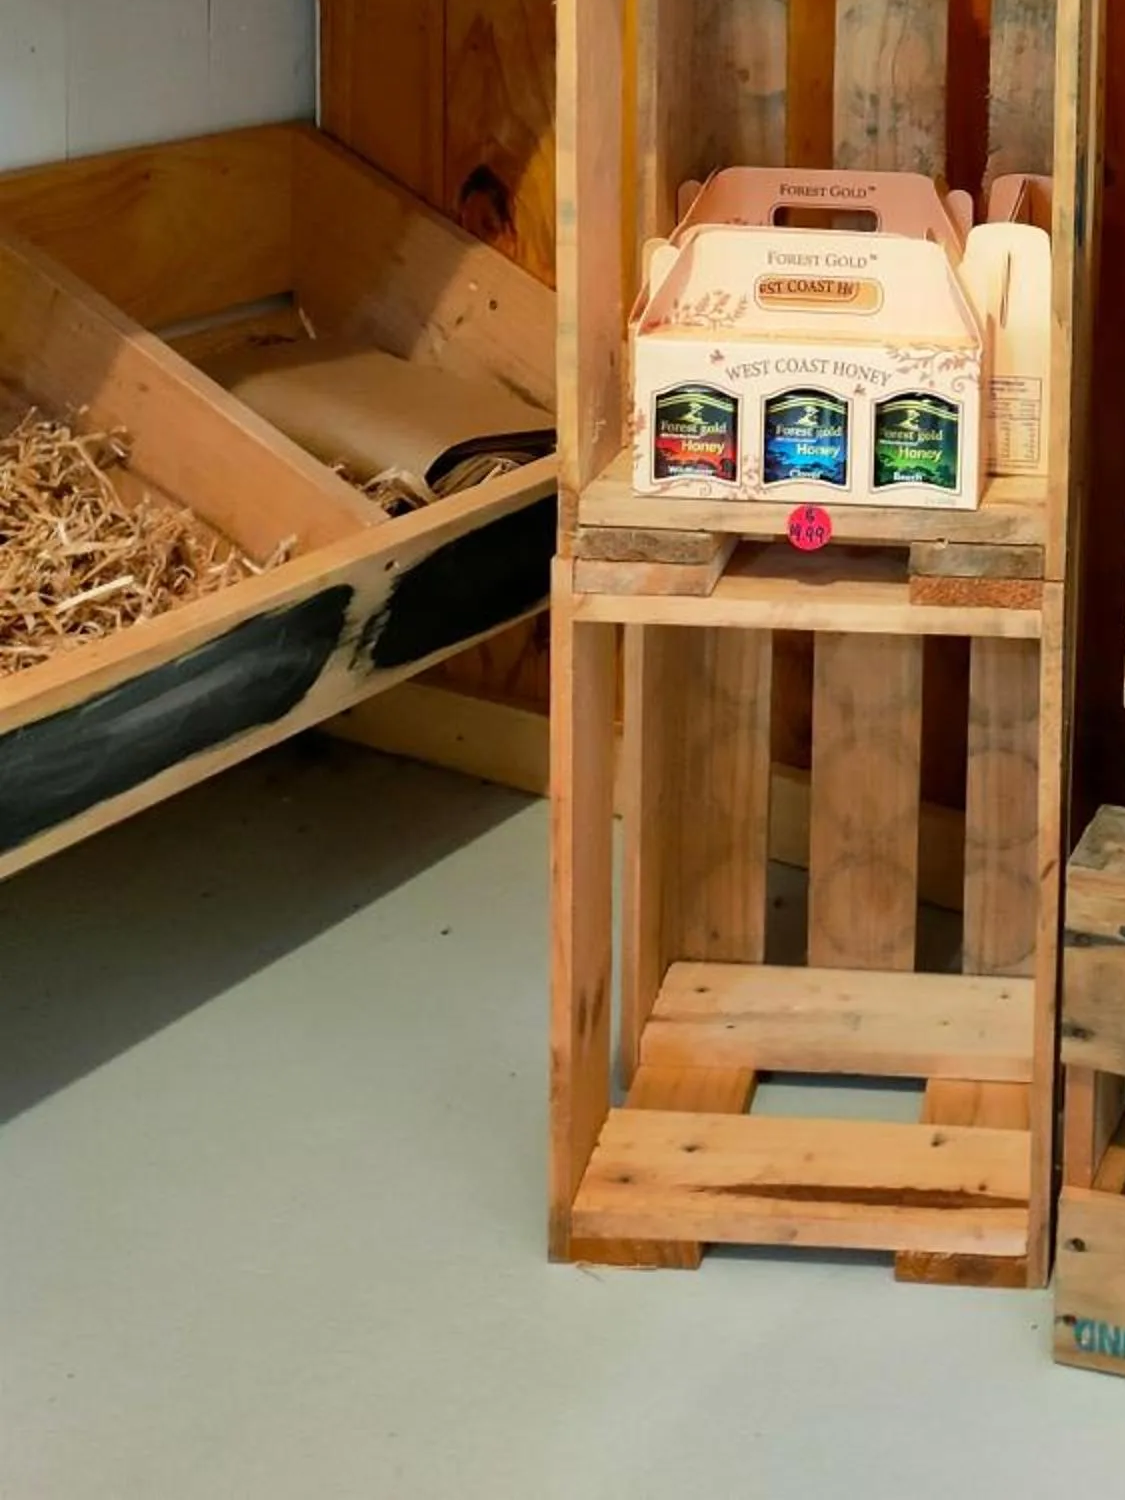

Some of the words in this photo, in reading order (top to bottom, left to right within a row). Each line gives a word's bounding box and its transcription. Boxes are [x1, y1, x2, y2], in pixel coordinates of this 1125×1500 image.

[780, 183, 825, 197] FOREST
[829, 185, 868, 199] GOLD
[766, 251, 820, 266] FOREST
[825, 253, 868, 268] GOLD
[759, 282, 783, 294] EST
[787, 280, 834, 293] COAST
[724, 360, 771, 381] WEST
[775, 357, 829, 375] COAST
[833, 362, 893, 387] HONEY
[681, 439, 725, 456] Honey
[796, 443, 841, 460] Honey
[900, 446, 943, 463] Honey
